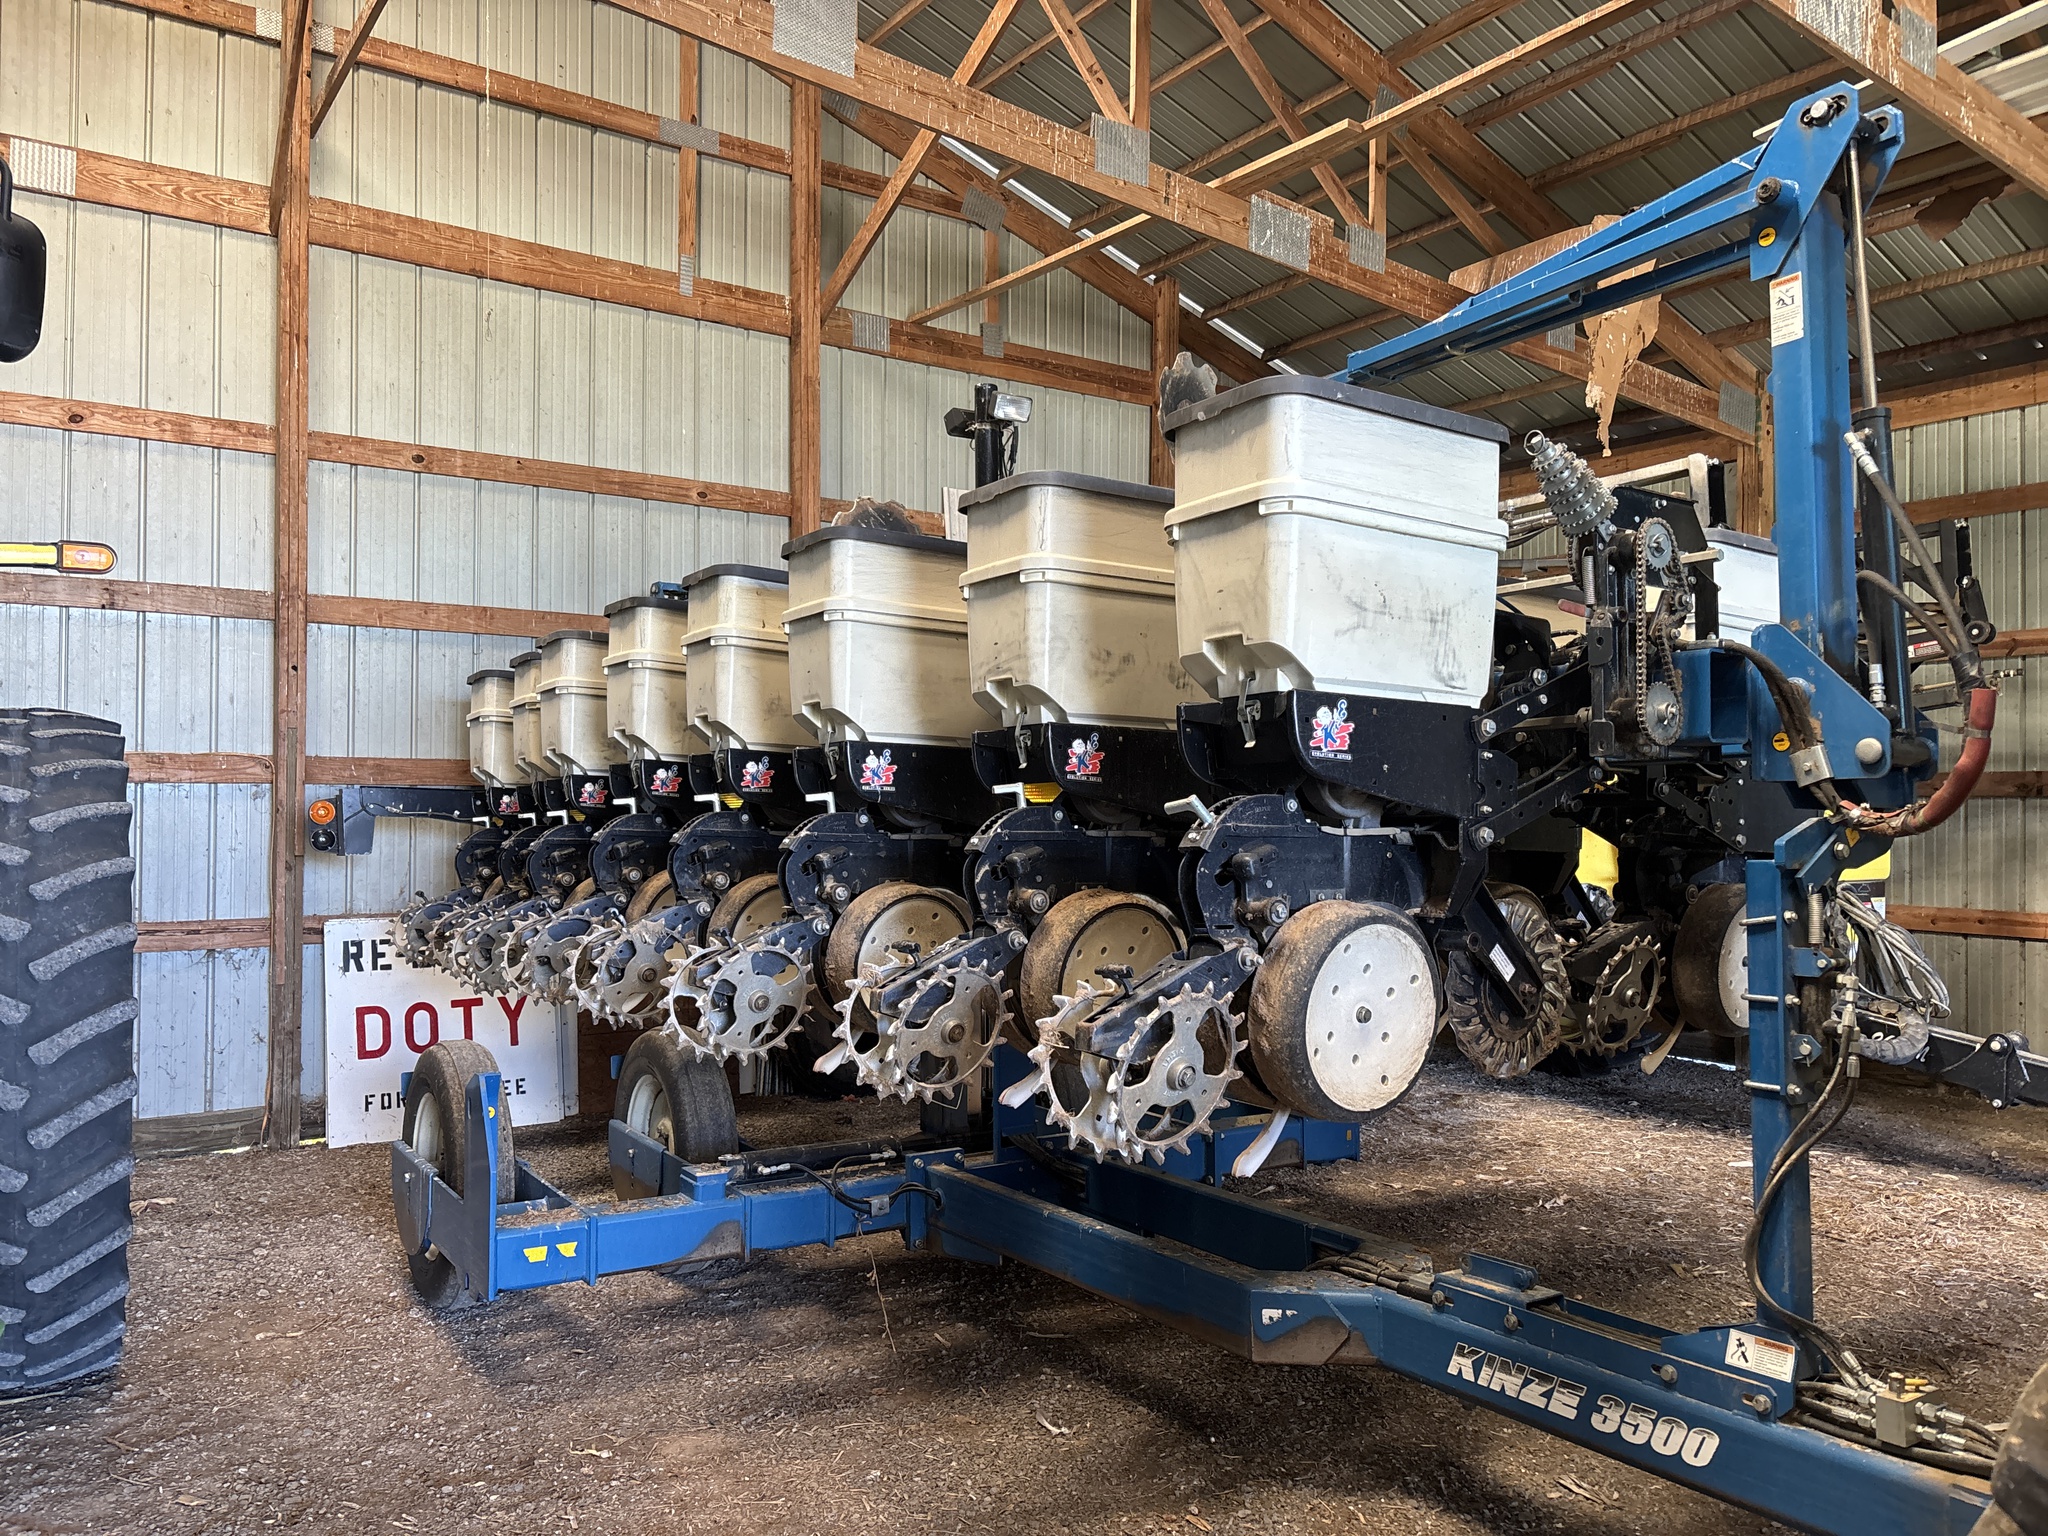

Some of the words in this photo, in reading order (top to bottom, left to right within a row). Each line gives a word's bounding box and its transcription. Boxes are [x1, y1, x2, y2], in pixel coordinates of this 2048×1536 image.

[355, 995, 528, 1060] DOTY
[1763, 1340, 1789, 1352] WARNING
[1446, 1341, 1587, 1420] KINZE
[1590, 1394, 1720, 1467] 3500
